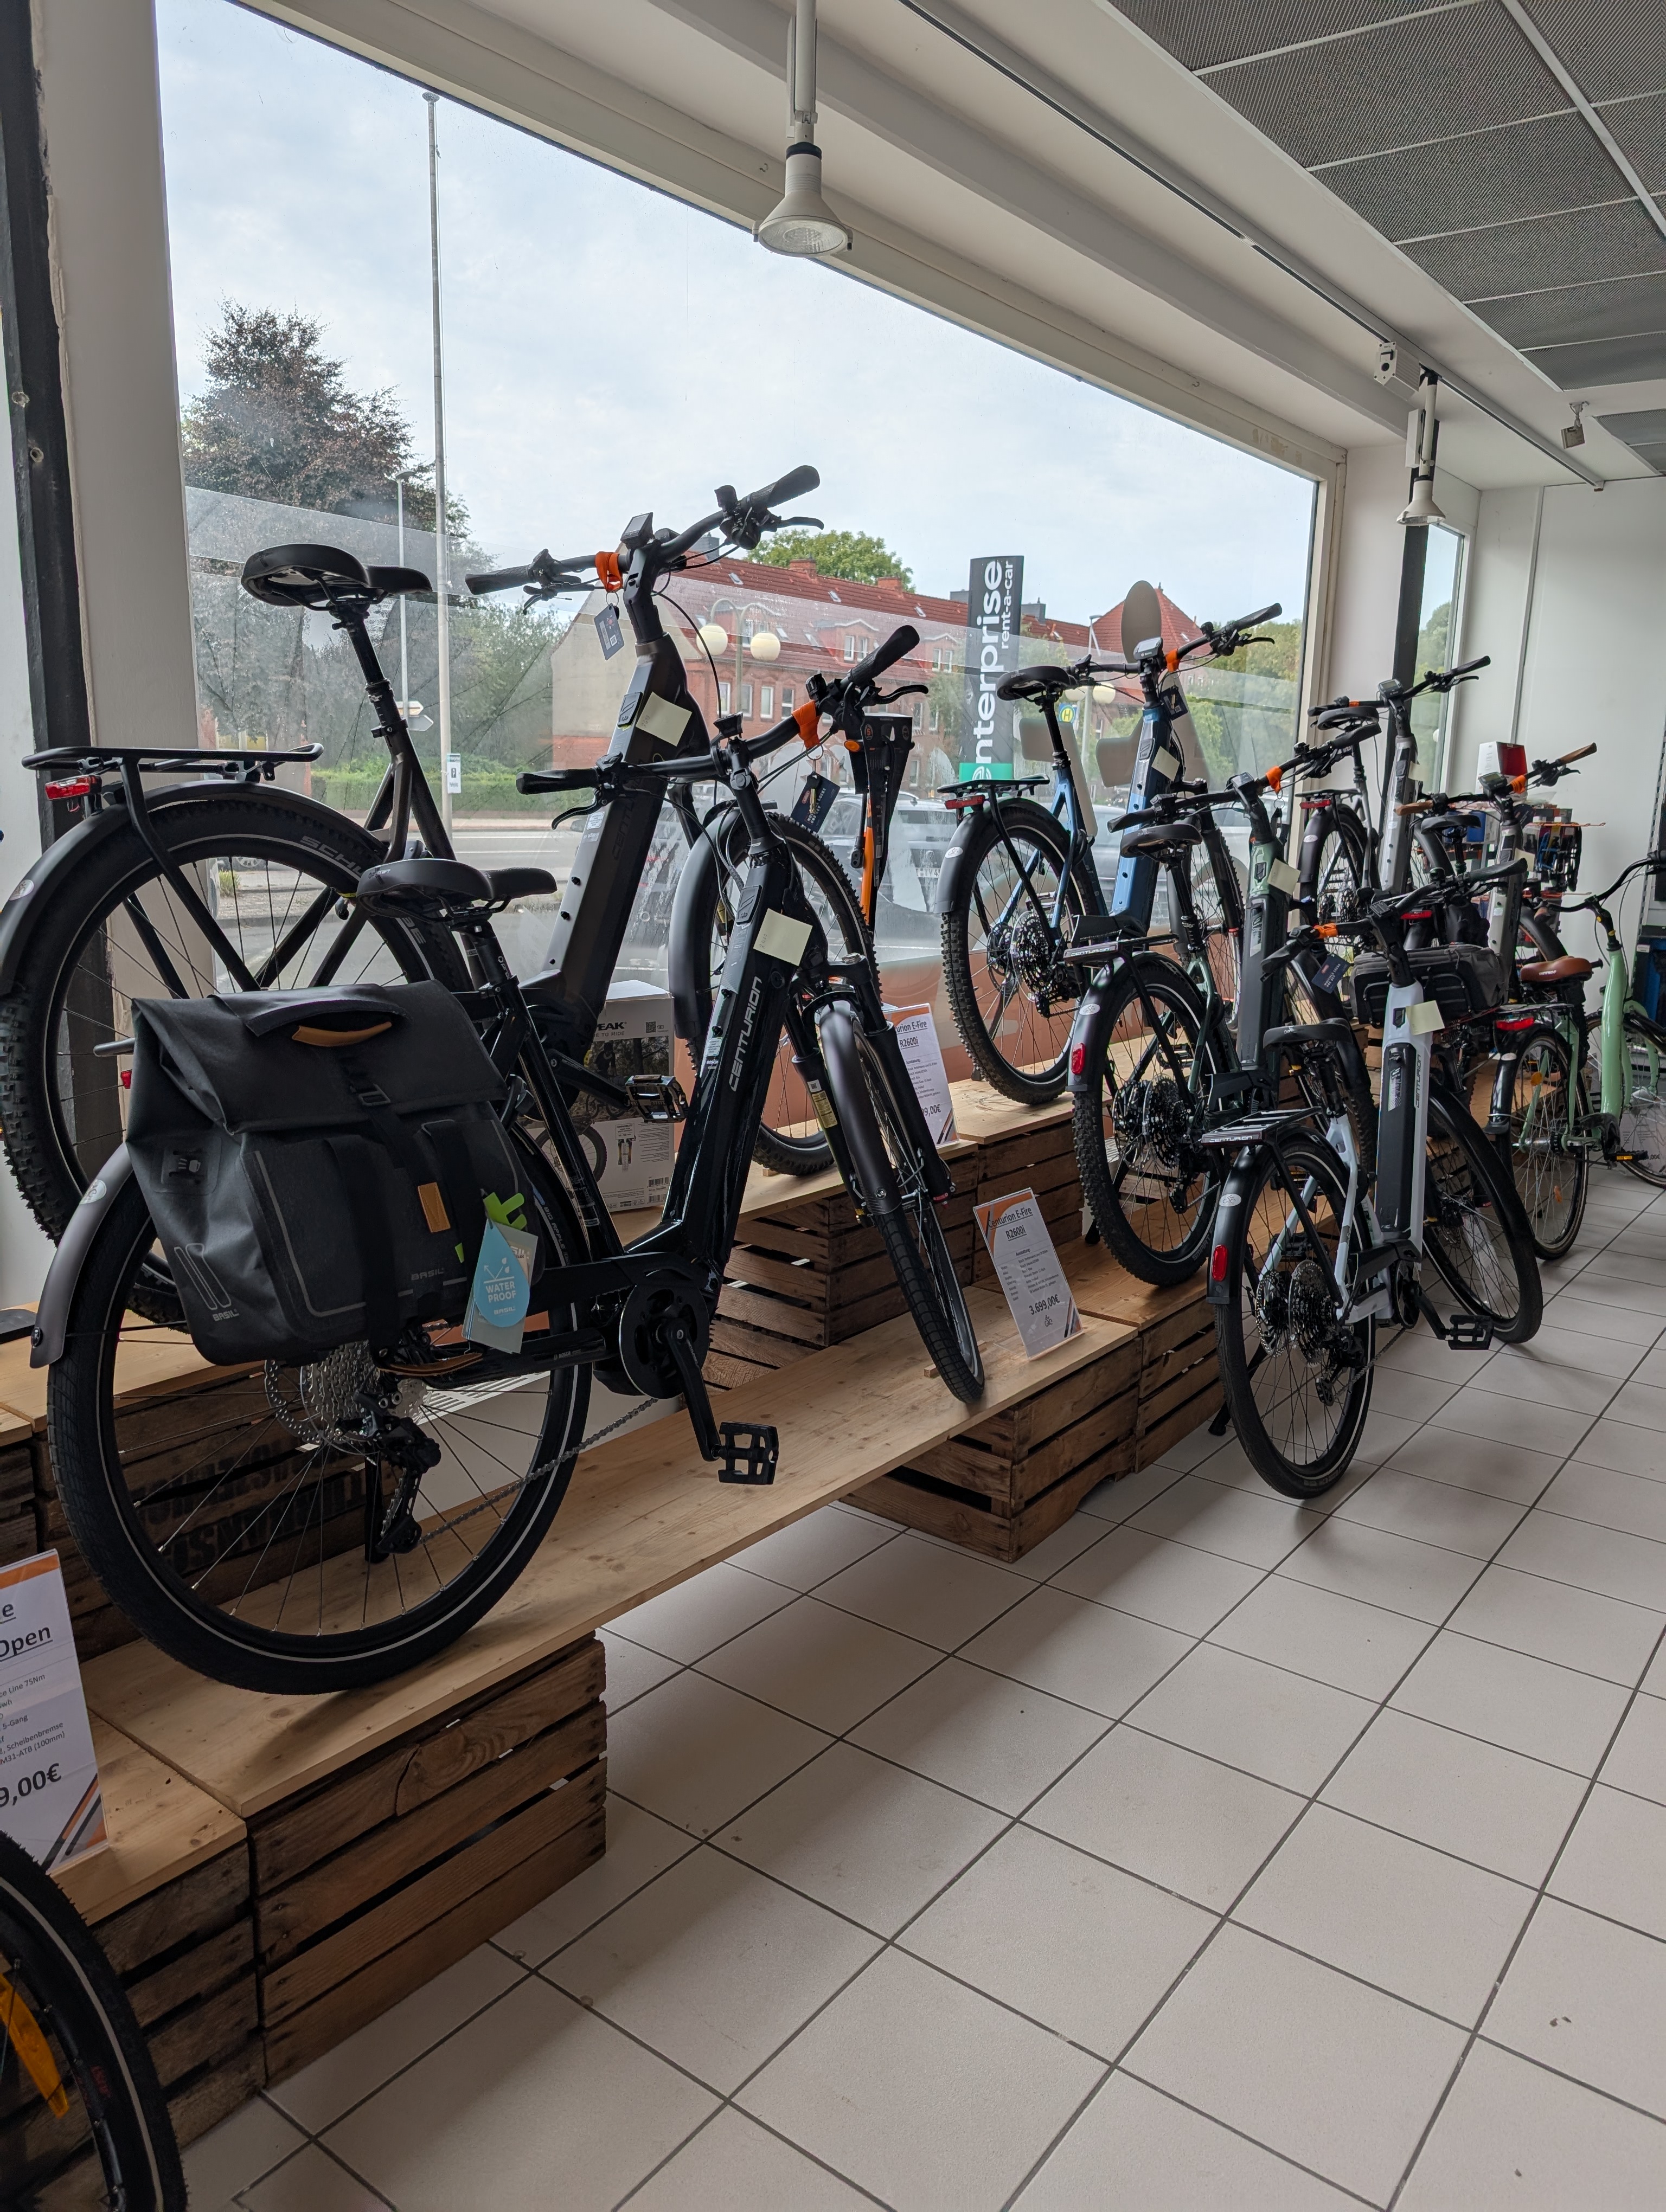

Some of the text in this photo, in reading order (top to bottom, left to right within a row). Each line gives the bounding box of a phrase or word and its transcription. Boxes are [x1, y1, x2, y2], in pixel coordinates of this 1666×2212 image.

[1002, 561, 1014, 650] rent-a-car
[598, 1021, 625, 1031] EAK
[912, 1020, 927, 1031] E-Fire
[729, 976, 762, 1092] CENTURION
[899, 1036, 919, 1049] R2600i
[988, 1207, 1033, 1229] Centurion E-Fire
[1005, 1224, 1027, 1239] R2600i
[485, 1281, 515, 1294] WATER
[488, 1290, 516, 1303] PROOF
[1029, 1294, 1060, 1315] 3.699,00€
[212, 1310, 240, 1322] BASIL
[24, 1674, 46, 1687] 75Nm
[7, 1722, 63, 1751] Scheibenbremse
[34, 1731, 65, 1751] (100mm)
[0, 1763, 62, 1808] 9,00€
